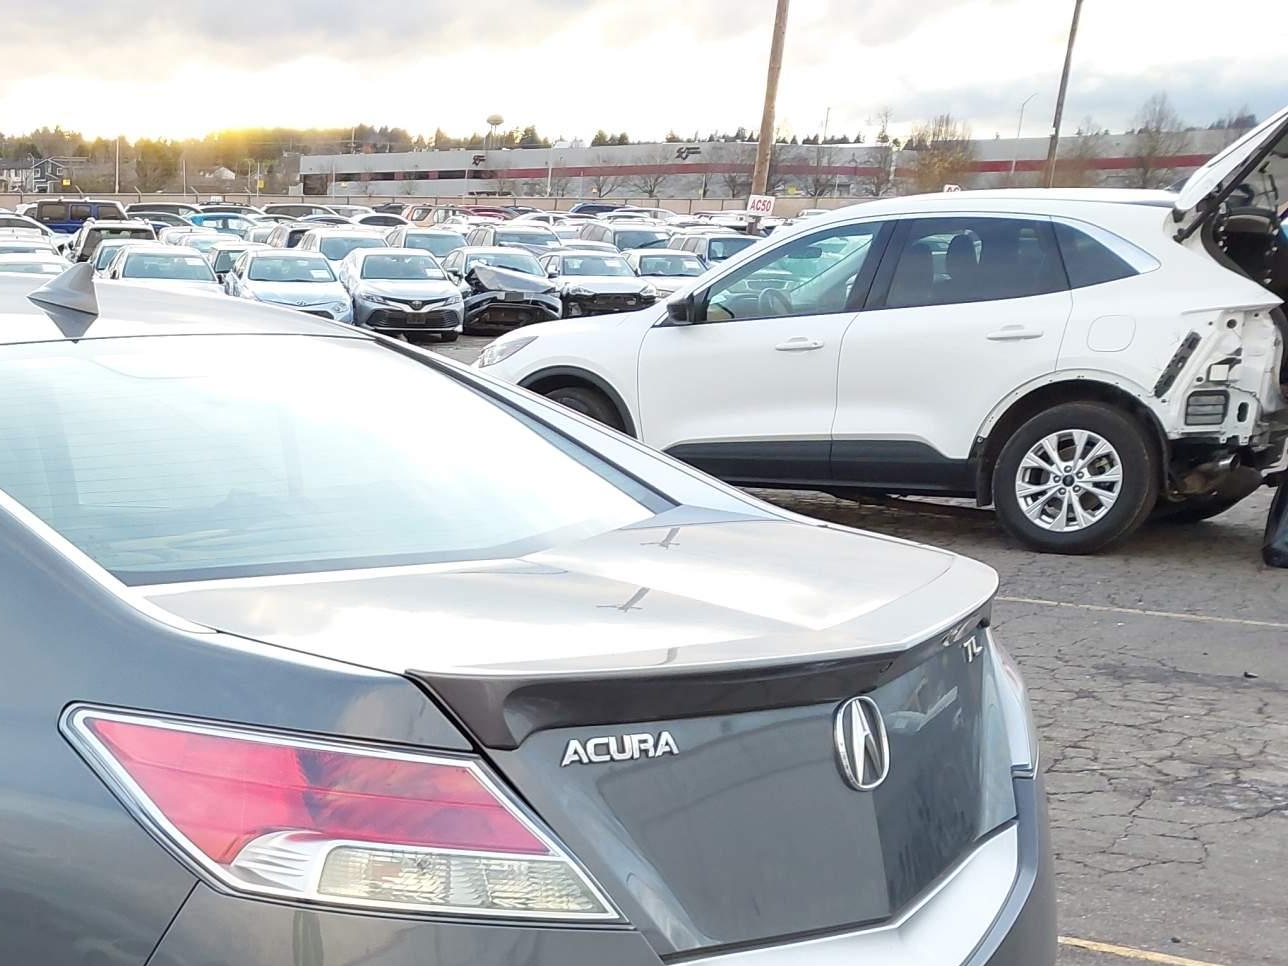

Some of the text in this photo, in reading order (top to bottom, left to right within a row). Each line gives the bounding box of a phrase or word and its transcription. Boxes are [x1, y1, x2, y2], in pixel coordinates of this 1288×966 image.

[750, 199, 772, 212] AC50
[963, 635, 983, 663] TL
[560, 730, 680, 768] ACURA
